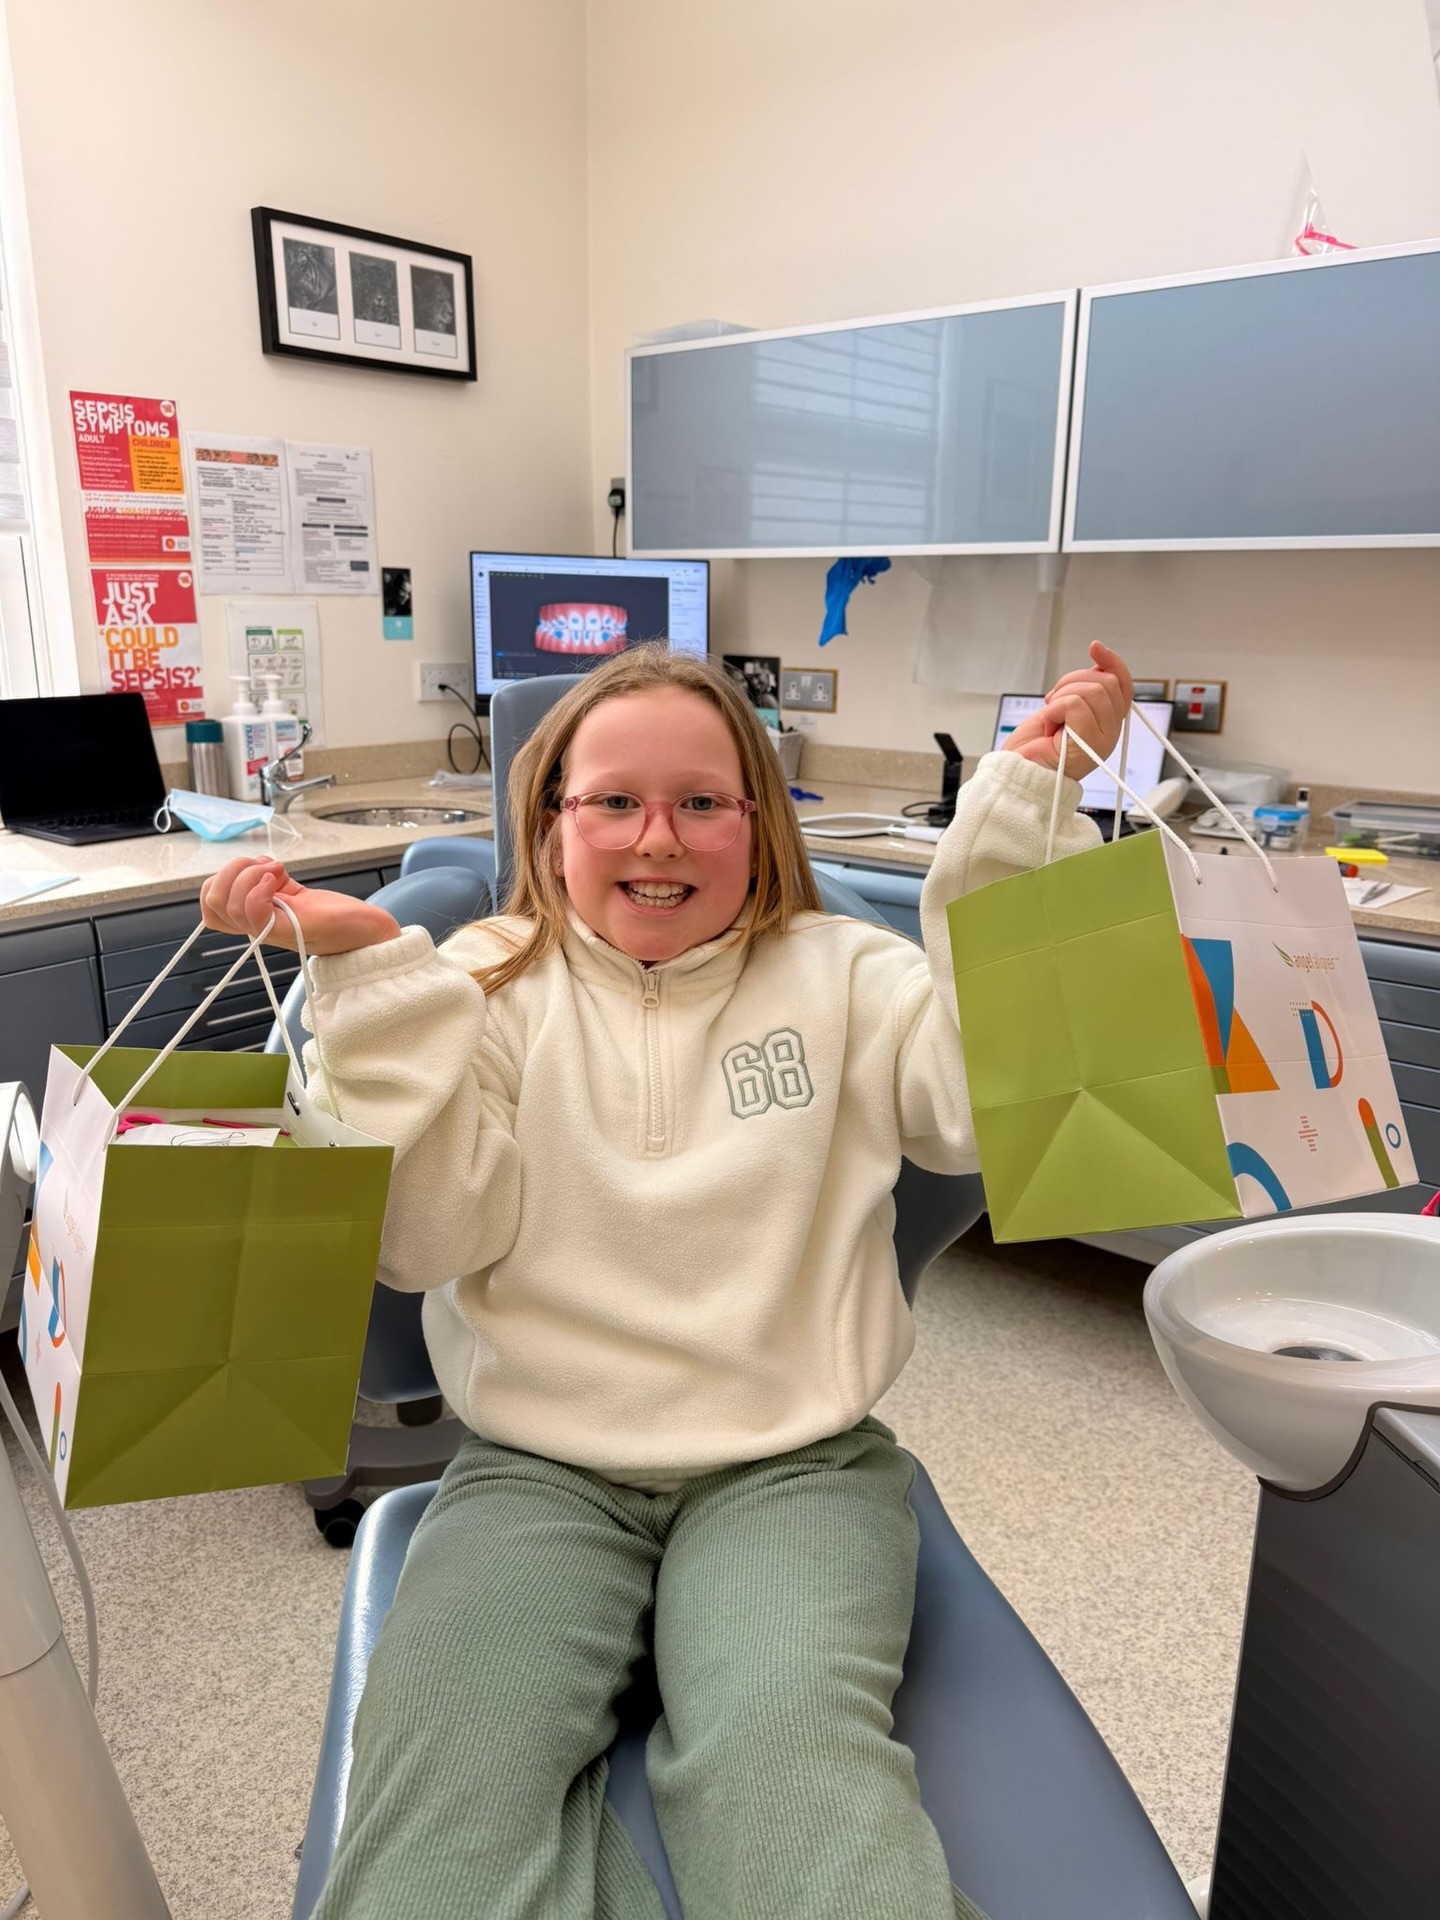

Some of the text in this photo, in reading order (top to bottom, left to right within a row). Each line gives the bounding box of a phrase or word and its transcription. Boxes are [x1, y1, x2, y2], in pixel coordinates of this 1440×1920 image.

[73, 399, 135, 420] SEPSIS
[75, 414, 170, 438] SYMPTOMS
[78, 433, 106, 444] ADULT
[132, 438, 172, 449] CHILDREN
[102, 582, 159, 605] JUST
[105, 602, 155, 626] ASK
[100, 627, 179, 649] 'COULD
[108, 648, 161, 671] IT BE
[721, 1027, 814, 1120] 68
